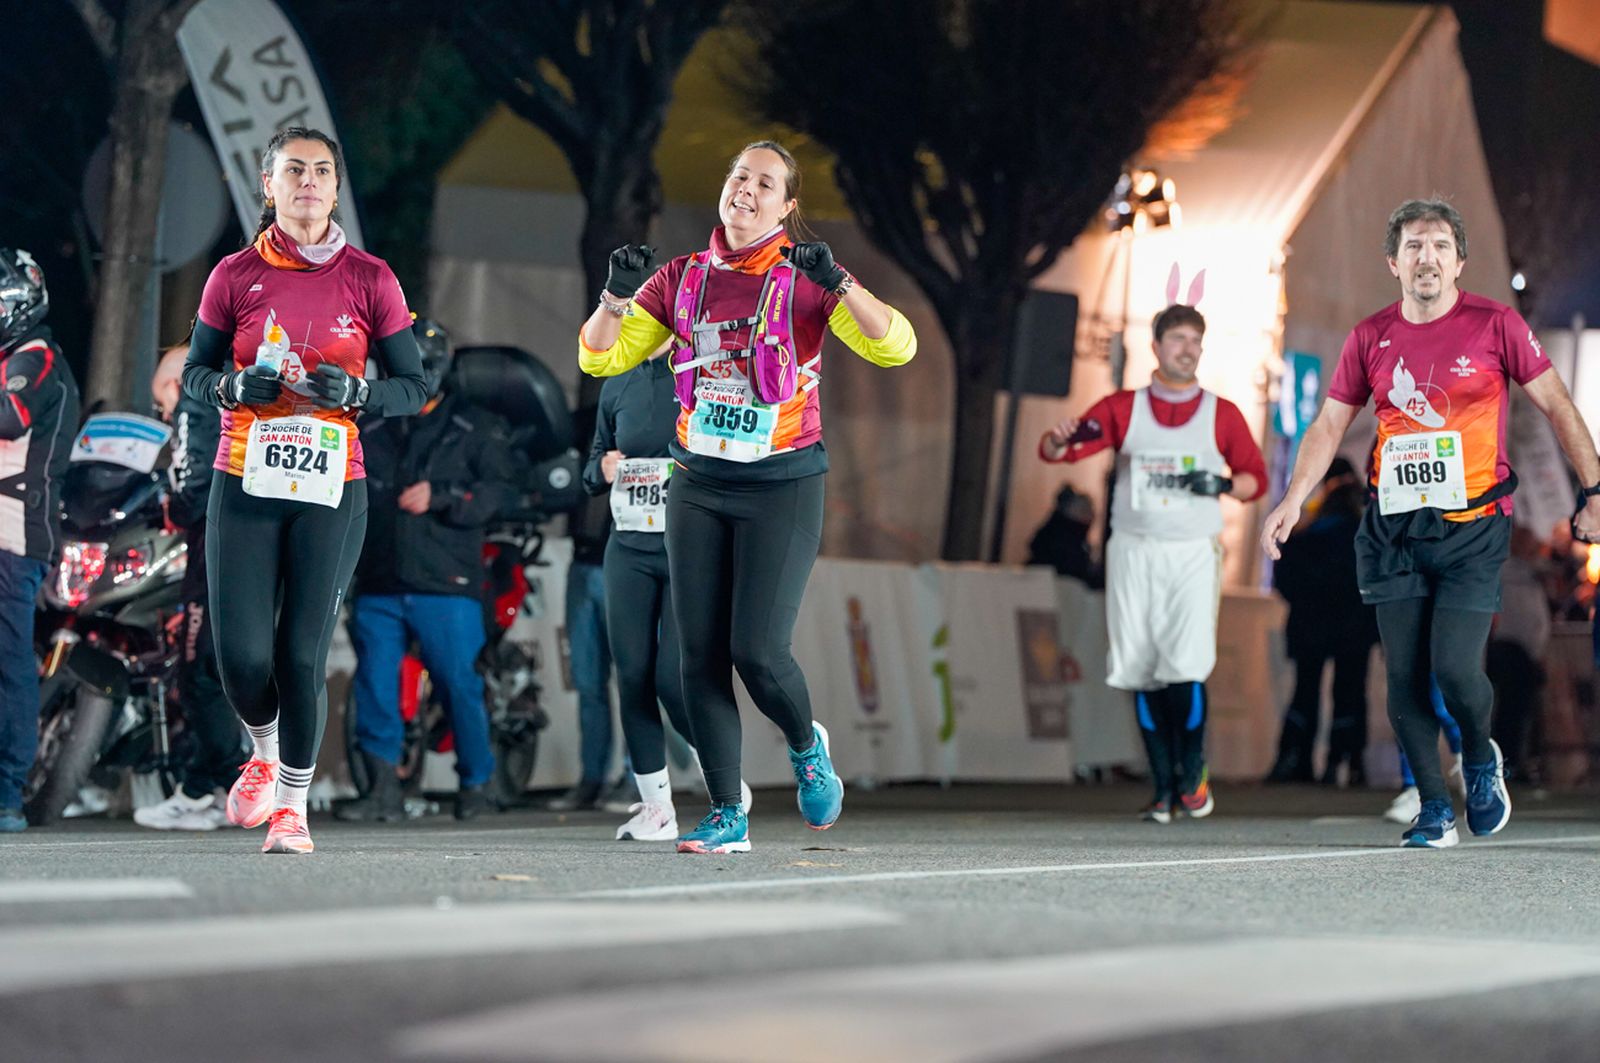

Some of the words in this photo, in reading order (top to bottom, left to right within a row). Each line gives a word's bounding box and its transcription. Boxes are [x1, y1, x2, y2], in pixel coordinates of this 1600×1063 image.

[280, 358, 300, 384] 43
[711, 360, 732, 379] 43
[1406, 397, 1426, 416] 43
[704, 402, 758, 433] 7859
[259, 433, 278, 443] SAN
[271, 425, 299, 433] NOCHE
[301, 426, 312, 435] DE
[1420, 442, 1428, 450] DE
[265, 443, 328, 475] 6324
[1393, 461, 1446, 486] 1689
